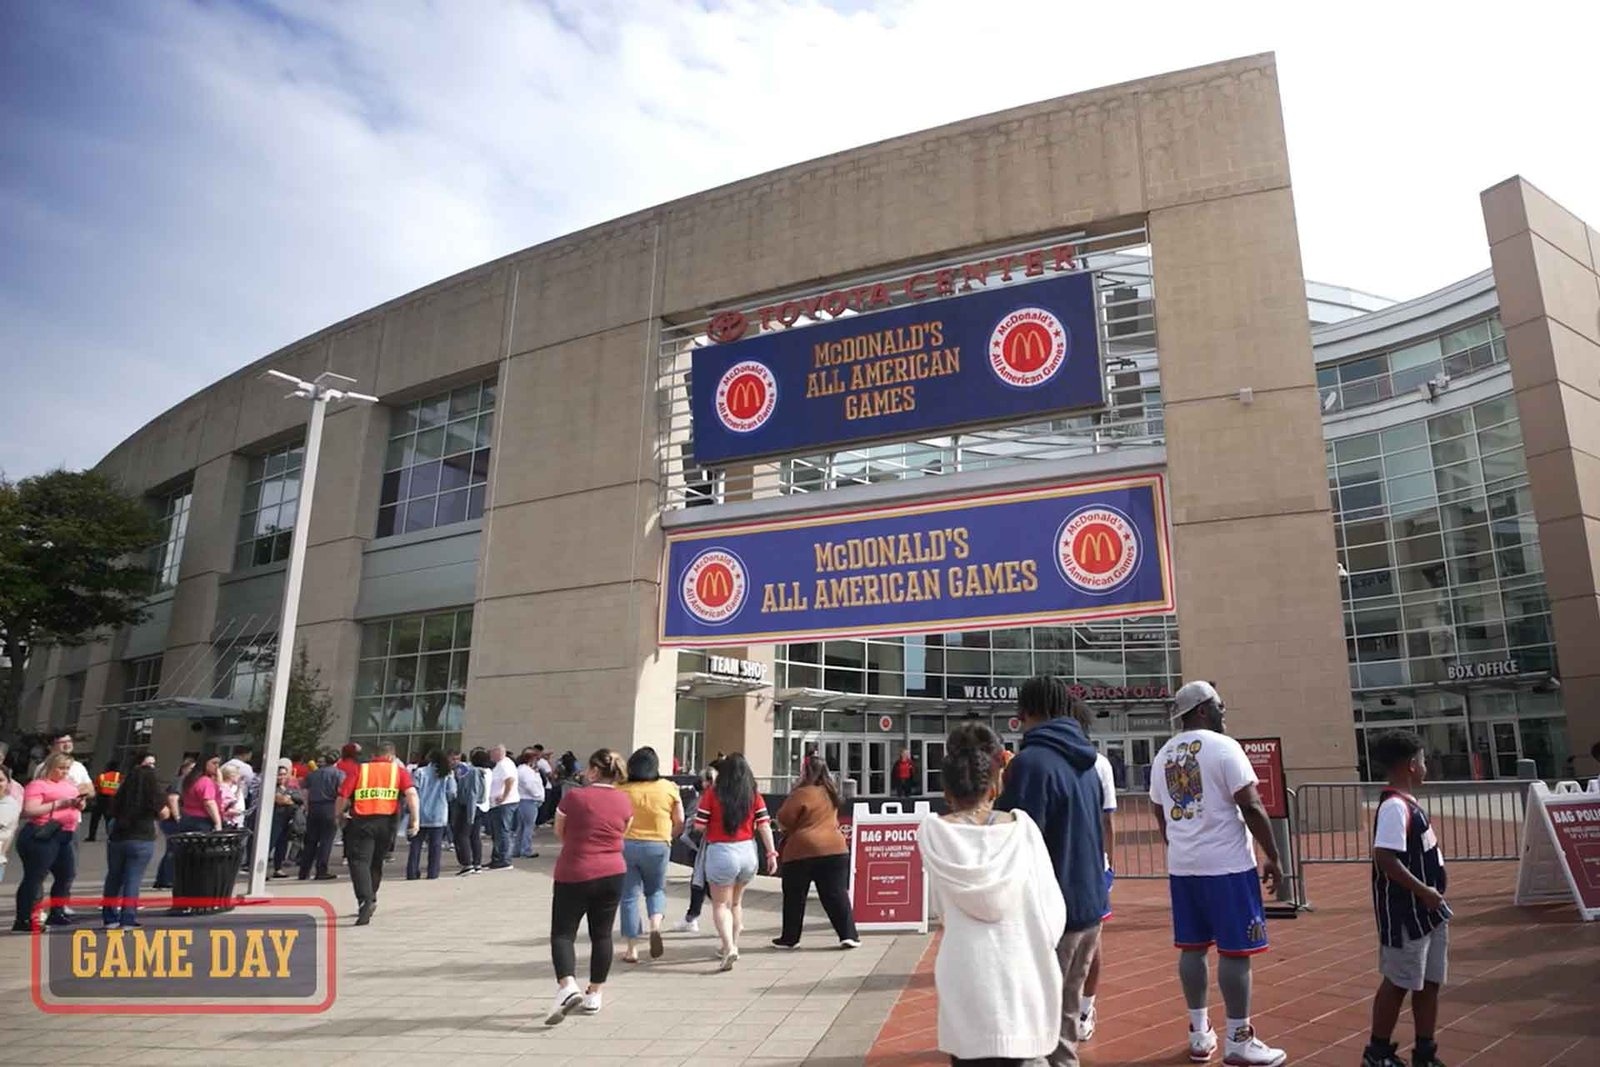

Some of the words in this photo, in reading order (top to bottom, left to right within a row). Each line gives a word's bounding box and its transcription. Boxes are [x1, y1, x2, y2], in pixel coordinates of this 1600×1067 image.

[758, 283, 889, 330] TOYOTA
[903, 244, 1076, 299] CENTER
[998, 312, 1054, 335] McDonald's
[806, 369, 846, 398] ALL
[851, 347, 960, 390] AMERICAN
[998, 366, 1043, 384] American
[1043, 343, 1064, 375] Games
[723, 365, 767, 386] McDonald's
[845, 386, 916, 420] GAMES
[1067, 513, 1123, 535] McDonald's
[1062, 553, 1073, 566] All
[1069, 566, 1113, 586] American
[1113, 546, 1134, 578] Games
[761, 582, 808, 613] ALL
[814, 569, 940, 609] AMERICAN
[949, 559, 1038, 597] GAMES
[690, 600, 726, 617] American
[711, 655, 739, 675] TEAM
[740, 660, 767, 680] SHOP
[1448, 664, 1474, 679] BOX
[1478, 660, 1519, 675] OFFICE
[963, 686, 1022, 699] WELCOM
[1244, 743, 1276, 752] POLICY
[1552, 811, 1575, 823] BAG
[860, 830, 882, 843] BAG
[885, 829, 919, 842] POLICY
